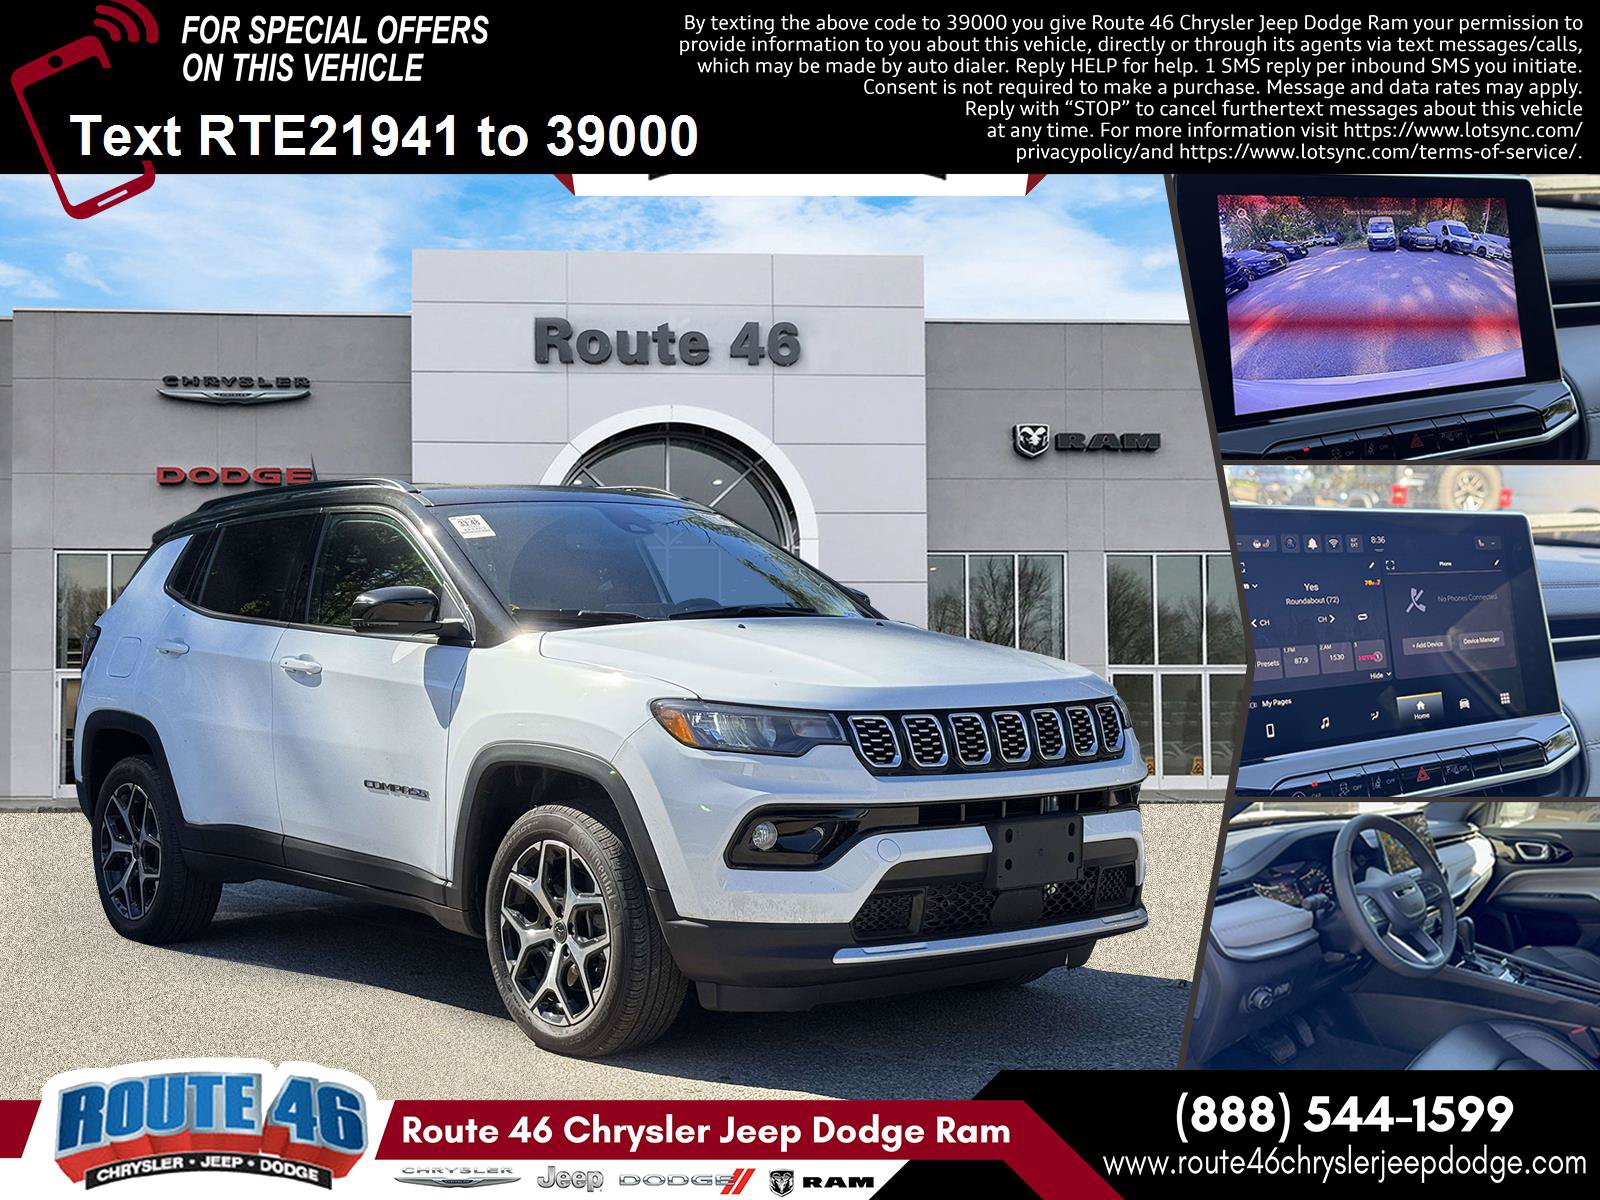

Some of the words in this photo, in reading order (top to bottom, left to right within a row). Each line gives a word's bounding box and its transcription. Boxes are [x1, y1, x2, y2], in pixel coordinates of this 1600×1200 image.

[534, 316, 710, 367] Route
[729, 320, 801, 368] 46
[162, 375, 311, 388] CHRYSLER
[1055, 432, 1161, 451] RAM
[156, 466, 313, 485] DODGE
[1371, 535, 1386, 544] 8:36
[1303, 583, 1319, 591] Yes
[1285, 597, 1325, 605] Roundabout
[1326, 596, 1340, 605] (72)
[1259, 619, 1270, 627] CH
[1427, 640, 1443, 648] Device
[1480, 636, 1500, 644] Manager
[1294, 656, 1309, 665] 87.9
[1329, 653, 1345, 661] 1530
[1256, 660, 1280, 668] Presets
[1370, 672, 1384, 680] Hide
[1262, 700, 1272, 708] My
[1272, 699, 1292, 707] Pages
[363, 779, 431, 799] COMPASS
